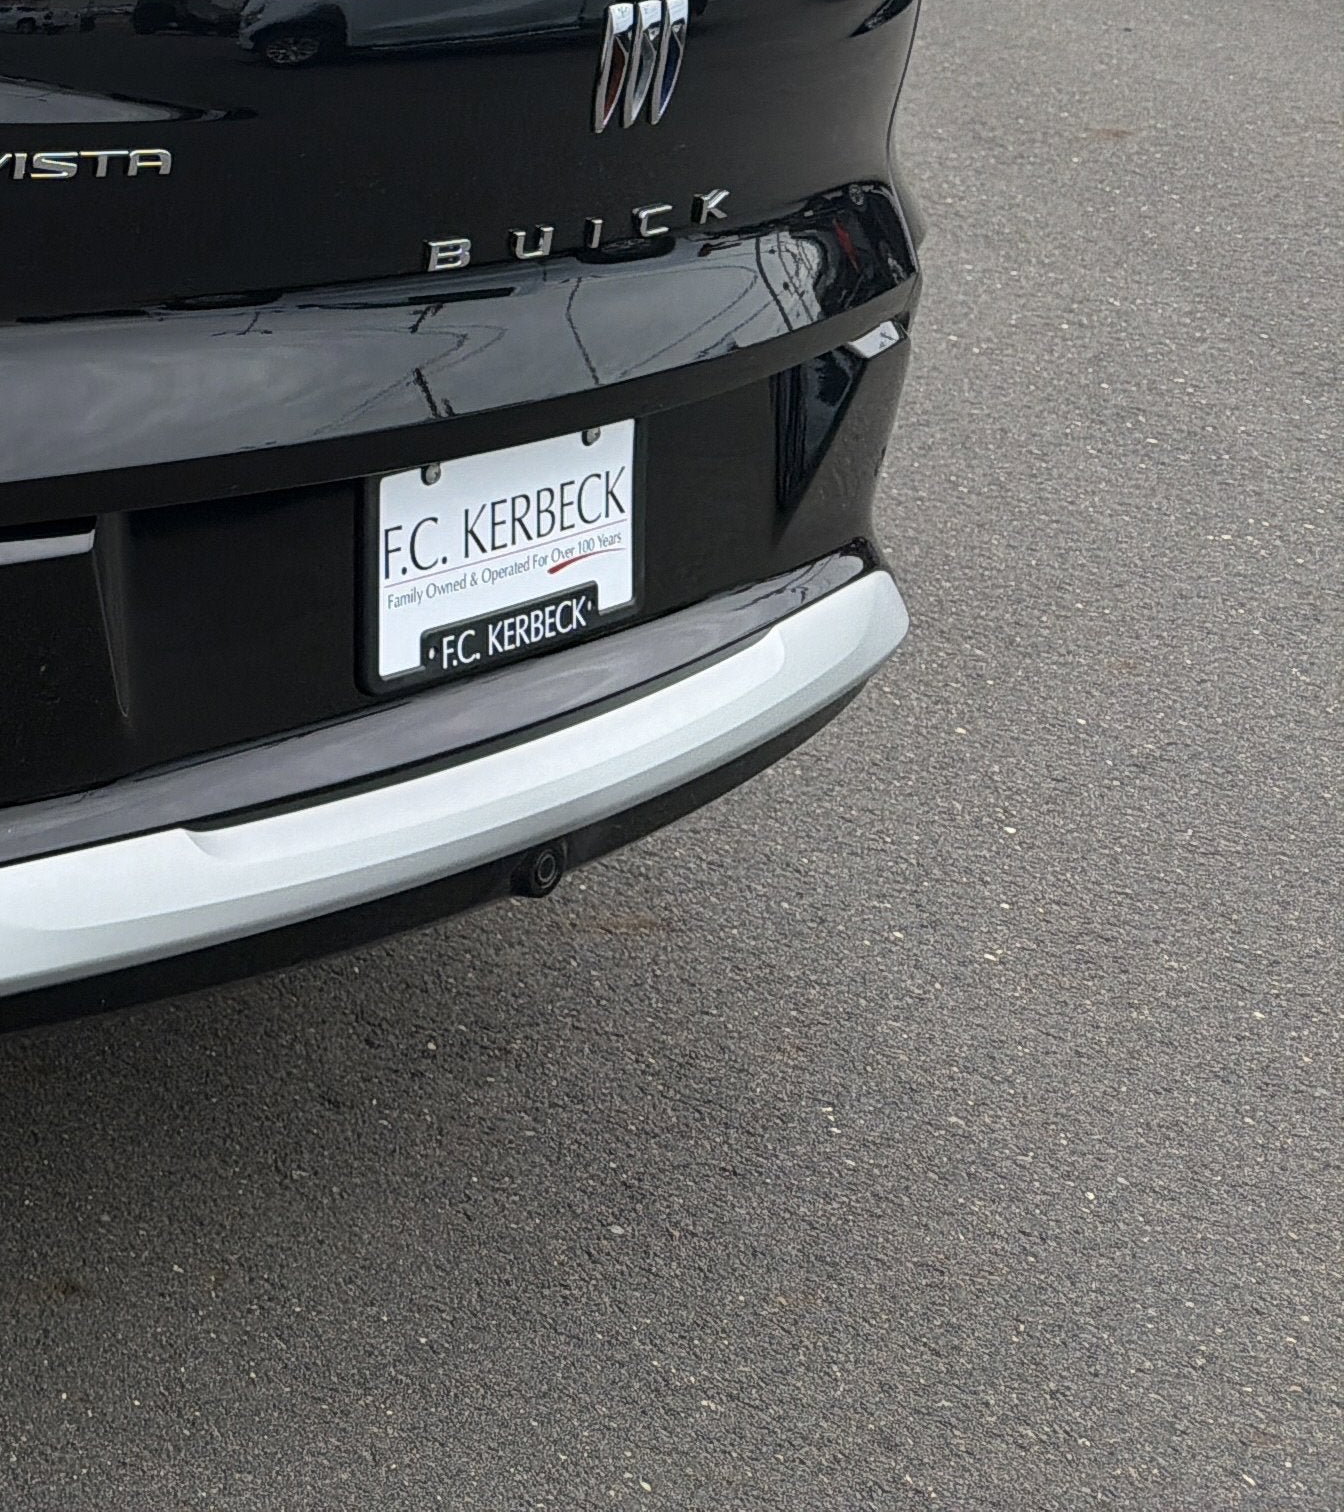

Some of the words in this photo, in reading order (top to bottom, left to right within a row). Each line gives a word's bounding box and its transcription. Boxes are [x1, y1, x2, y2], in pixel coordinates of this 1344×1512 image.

[423, 188, 730, 274] BUICK
[383, 516, 448, 580] F.C.
[464, 465, 627, 559] KERBECK
[387, 588, 424, 610] Family
[426, 574, 467, 598] Owned
[469, 571, 479, 587] &
[481, 556, 531, 585] Operated
[532, 550, 548, 568] For
[550, 545, 576, 564] Over
[577, 539, 595, 555] 100
[598, 531, 623, 550] Years
[441, 629, 481, 671] F.C.
[487, 595, 587, 656] KERBECK
